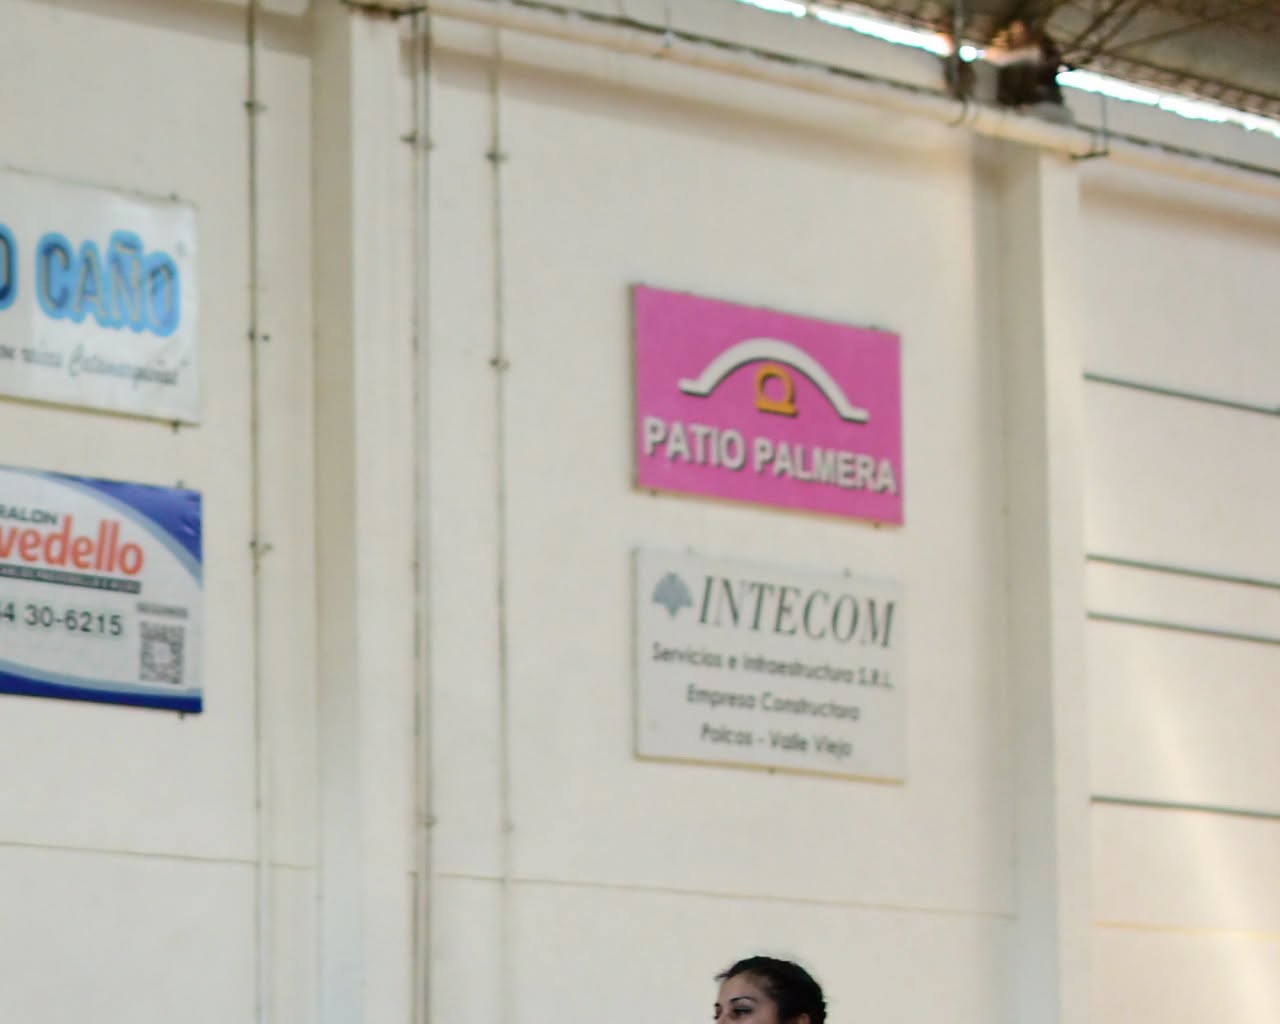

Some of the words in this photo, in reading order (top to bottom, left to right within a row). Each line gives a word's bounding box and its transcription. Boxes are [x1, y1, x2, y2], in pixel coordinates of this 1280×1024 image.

[35, 231, 181, 337] CAÑO
[644, 416, 746, 472] PATIO
[753, 437, 898, 495] PALMERA
[24, 604, 123, 636] 30-6215
[697, 575, 896, 648] INTECOM
[652, 641, 722, 669] Servicios
[686, 683, 756, 711] Empresa
[770, 730, 809, 752] Valle
